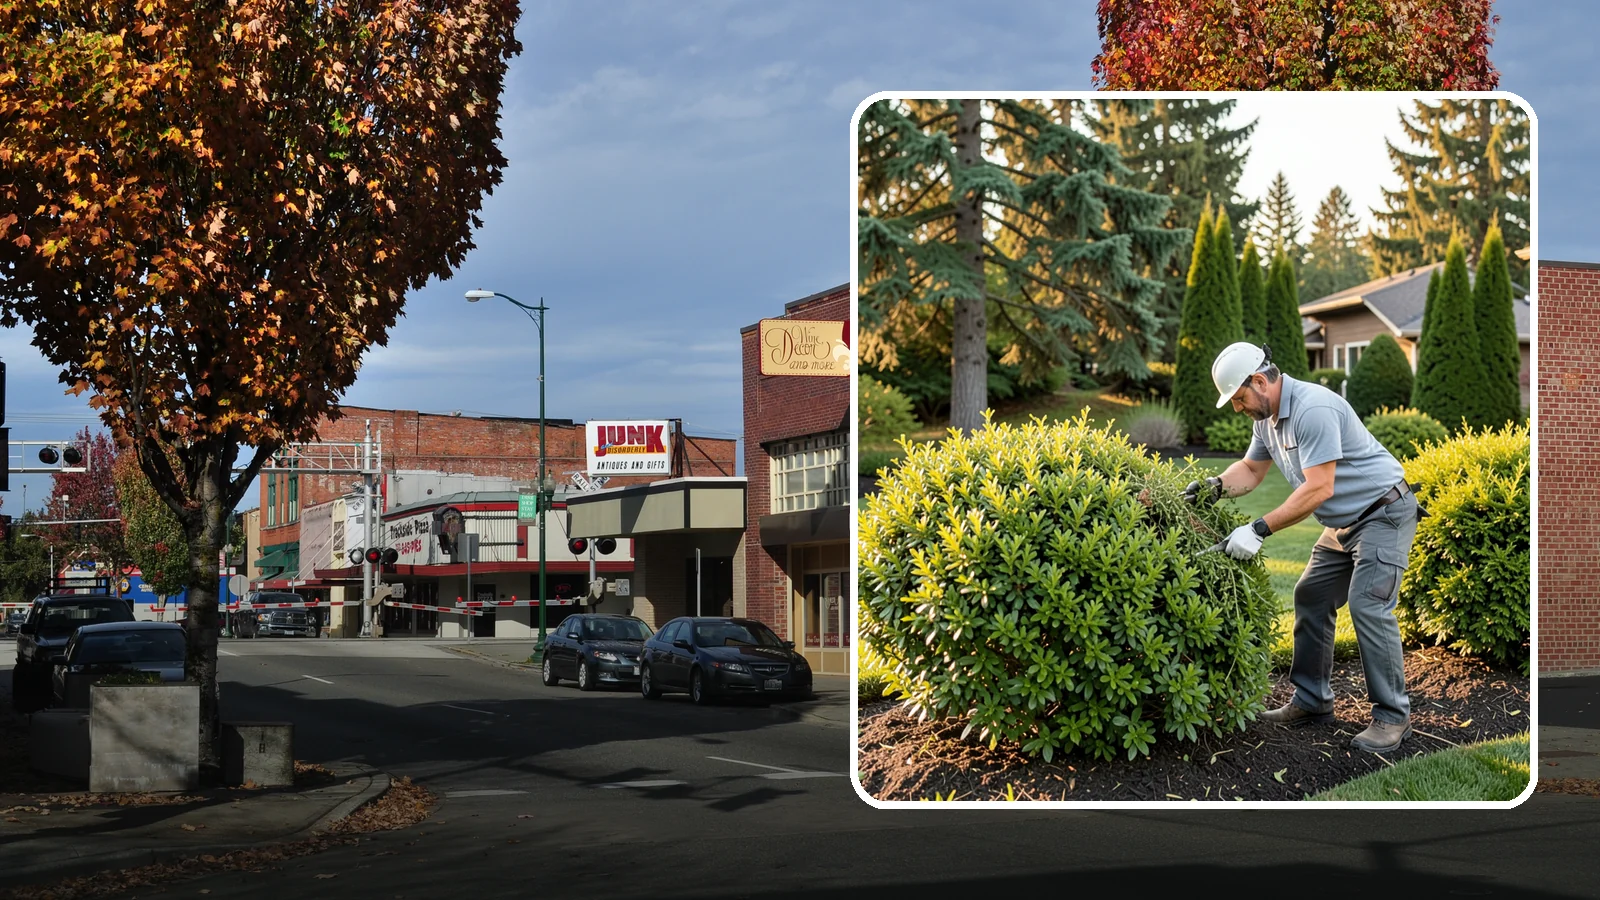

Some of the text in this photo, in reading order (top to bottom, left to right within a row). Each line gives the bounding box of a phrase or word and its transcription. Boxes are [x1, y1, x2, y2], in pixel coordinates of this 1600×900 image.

[595, 425, 665, 457] JUNK
[608, 446, 646, 454] DISORDERLY
[597, 460, 666, 470] ANTIQUES AND GIFTS
[573, 473, 588, 491] RAIL
[414, 519, 429, 535] Pizza
